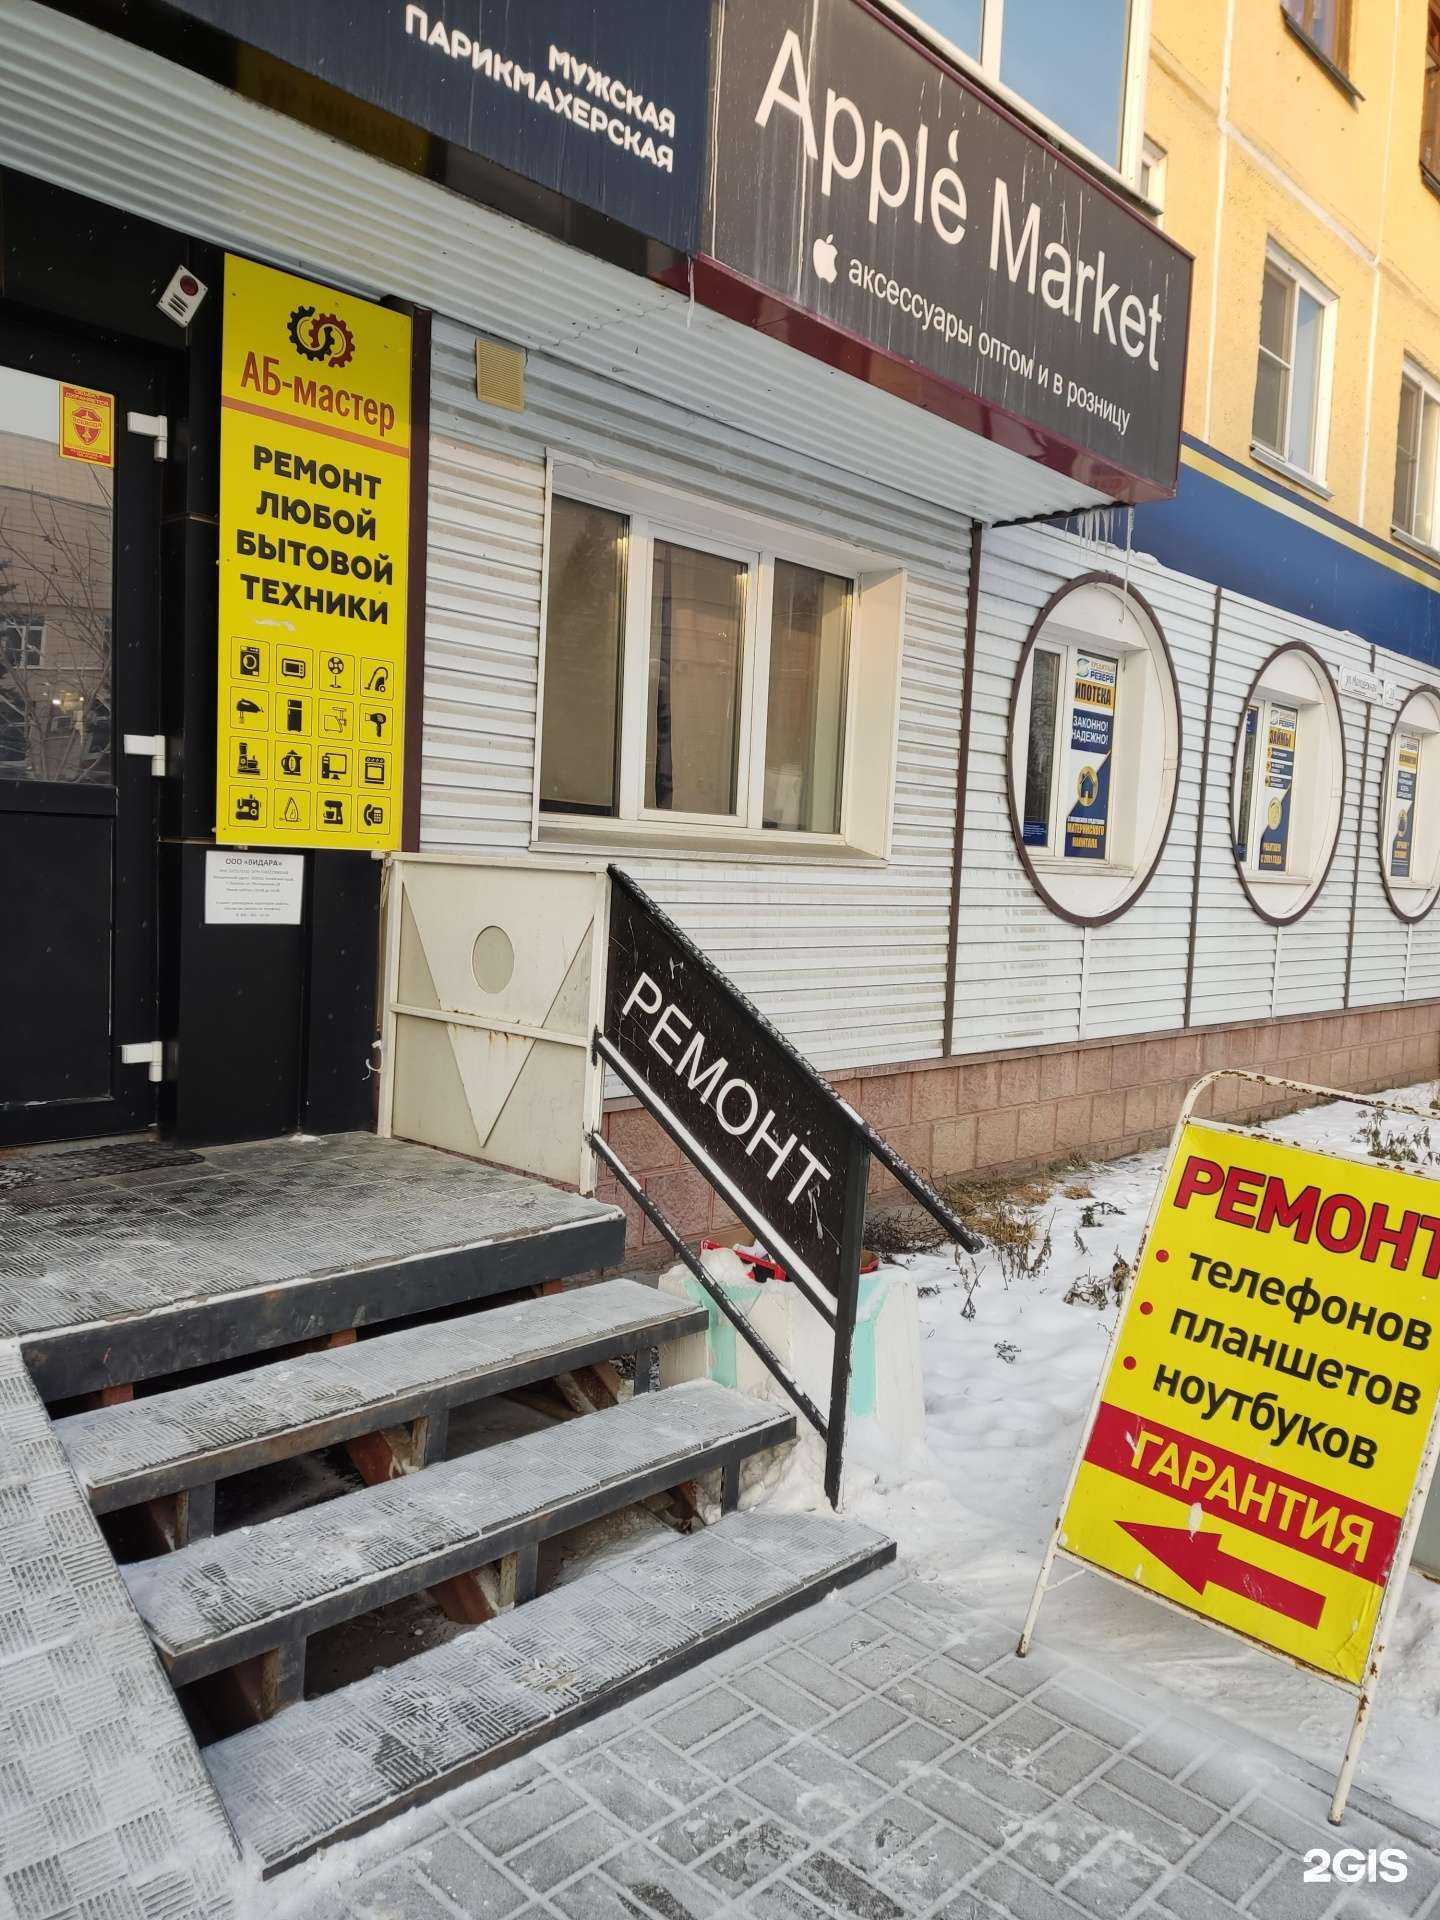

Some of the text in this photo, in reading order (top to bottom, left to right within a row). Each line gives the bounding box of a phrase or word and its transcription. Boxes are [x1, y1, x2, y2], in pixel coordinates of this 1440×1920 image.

[405, 3, 674, 173] ПАРИКМАХЕРСКАЯ
[549, 44, 675, 138] МУЖСКАЯ
[989, 178, 1162, 371] Market
[240, 351, 395, 436] АБ-мастер
[848, 257, 1130, 436] аксессуары оптом и в розницу
[253, 445, 382, 500] РЕМОНТ
[256, 489, 377, 541] ЛЮБОЙ
[236, 529, 393, 585] БЫТОВОЙ
[240, 574, 389, 625] ТЕХНИКИ
[1073, 715, 1109, 733] ЗАКОННО!
[1074, 681, 1111, 706] ИПОТЕКА
[622, 971, 831, 1204] РЕМОНТ
[1189, 1251, 1433, 1351] телефонов
[1169, 1307, 1422, 1415] планшетов
[1153, 1363, 1379, 1470] ноутбуков
[1127, 1431, 1374, 1564] ГАРАНТИЯ
